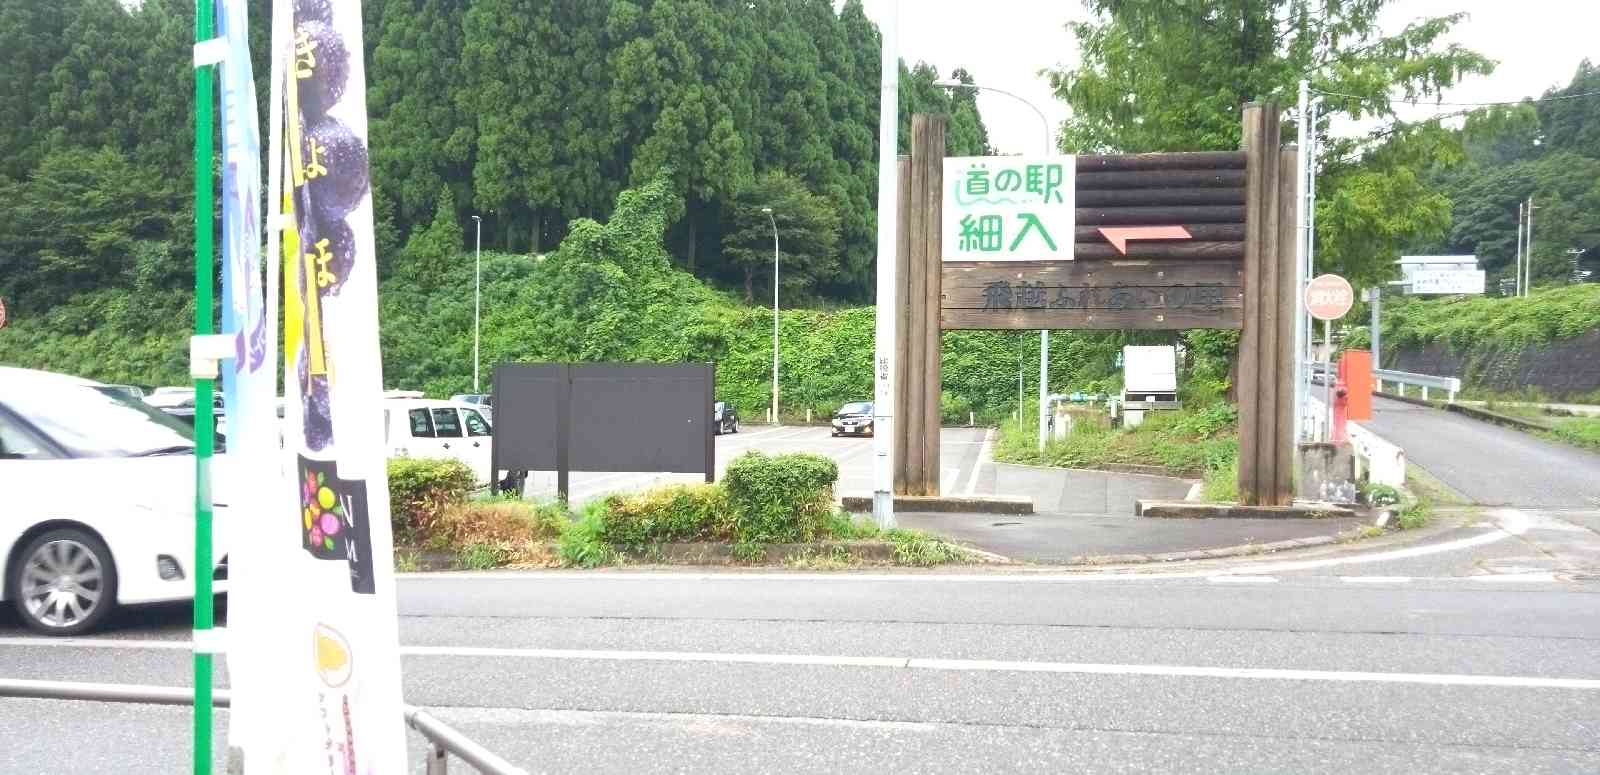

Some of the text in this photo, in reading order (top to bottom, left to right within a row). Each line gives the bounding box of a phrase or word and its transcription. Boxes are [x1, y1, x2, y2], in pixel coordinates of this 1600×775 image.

[955, 163, 1064, 206] 道の駅
[958, 213, 1058, 253] 細入
